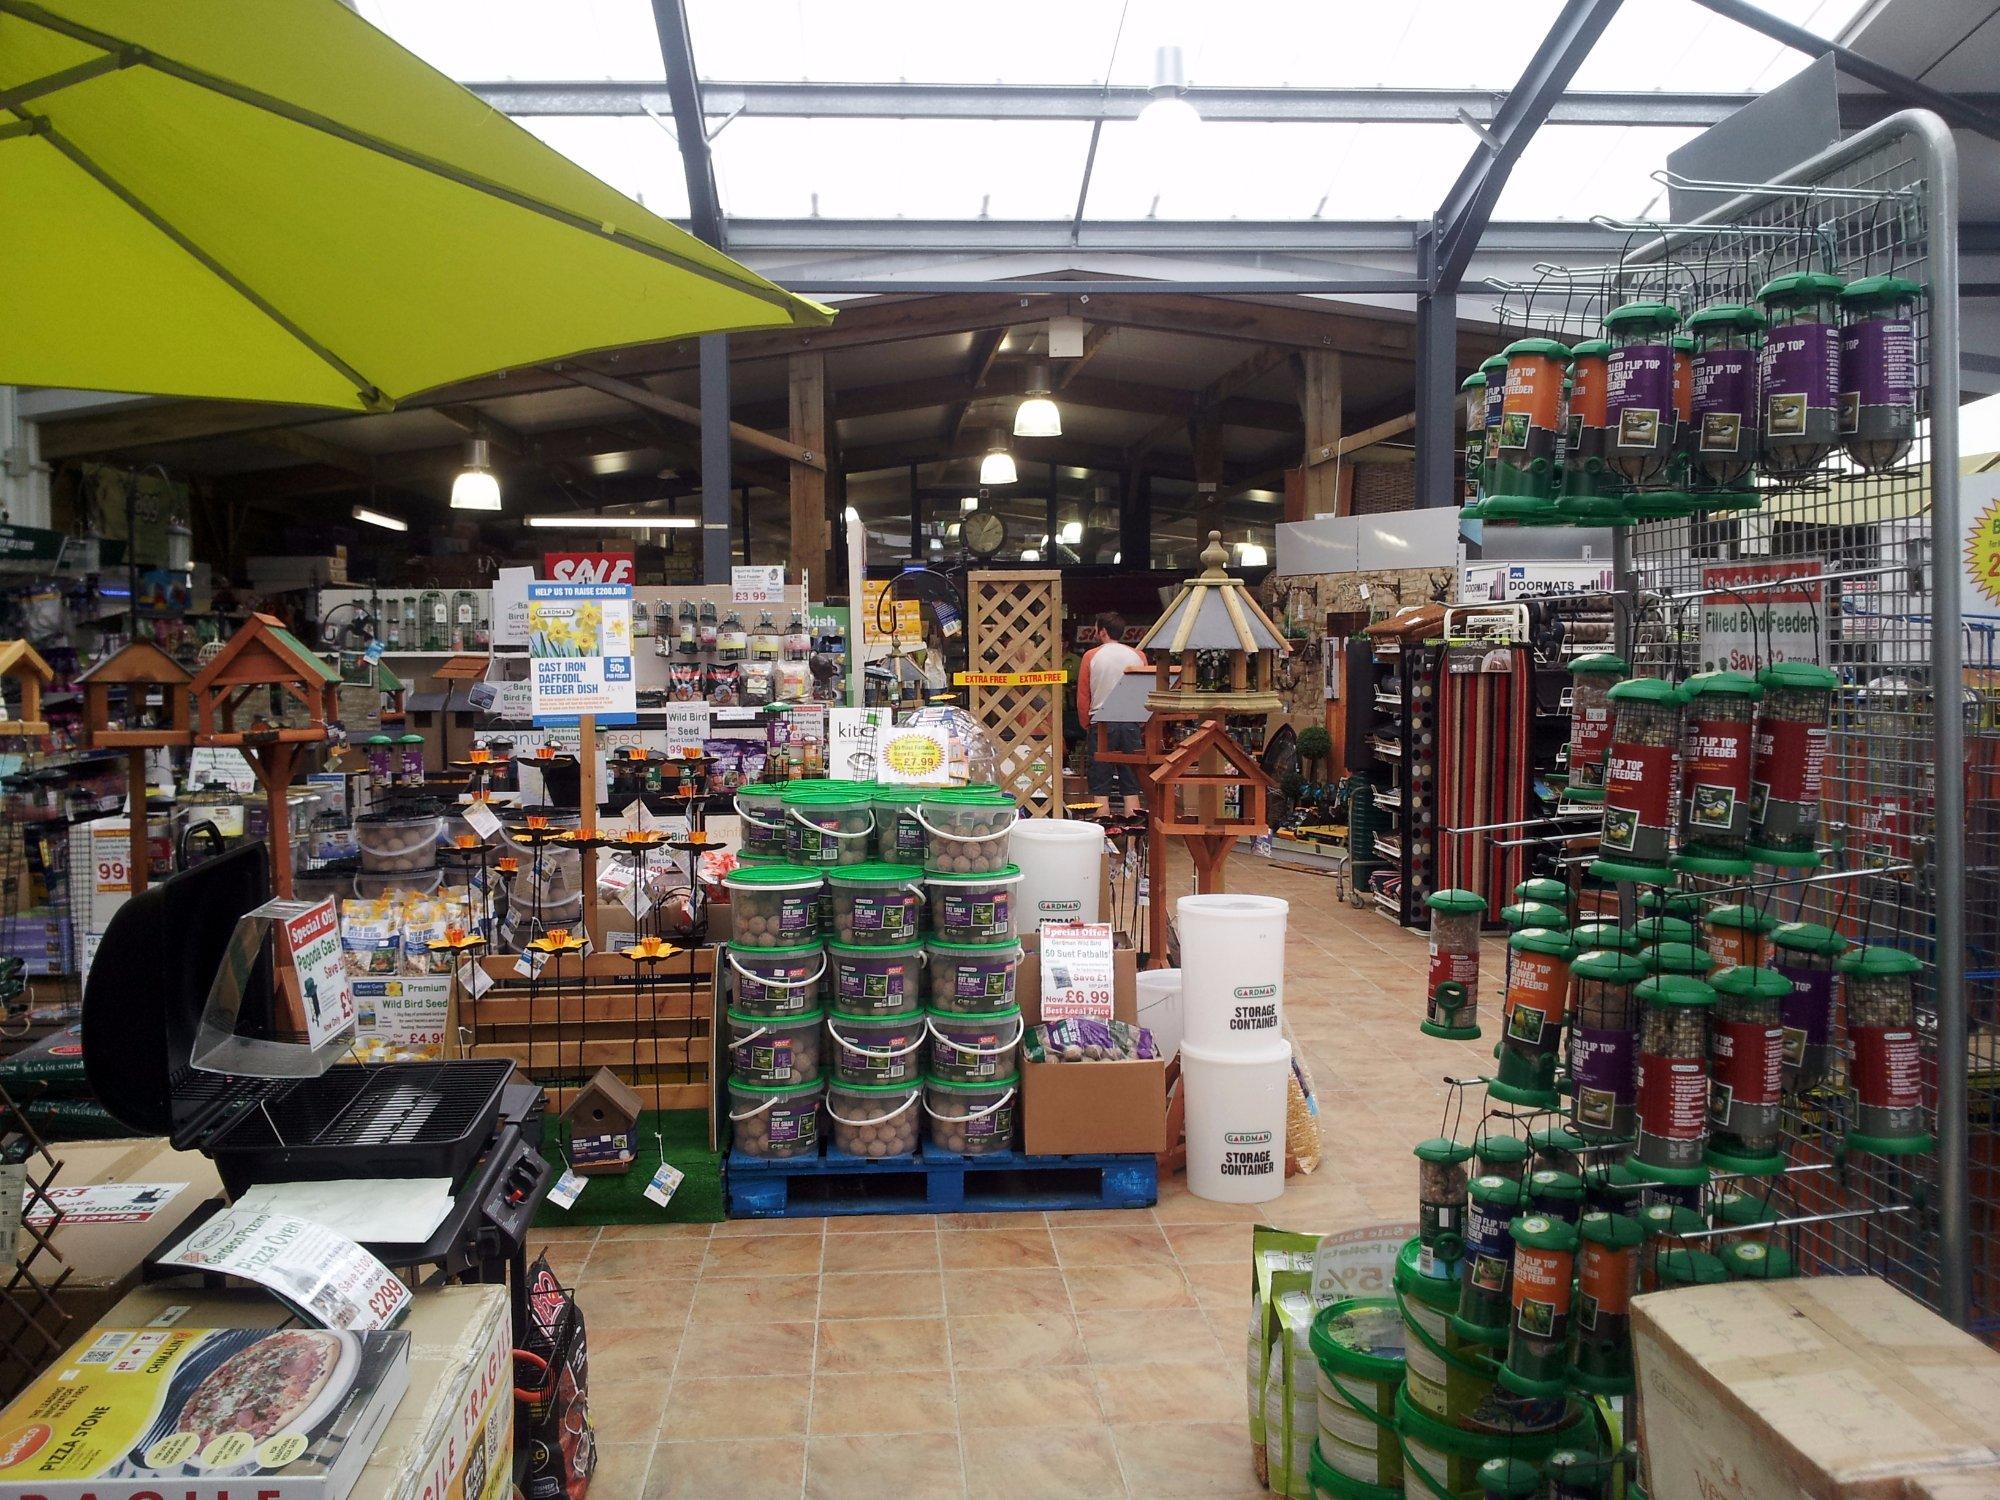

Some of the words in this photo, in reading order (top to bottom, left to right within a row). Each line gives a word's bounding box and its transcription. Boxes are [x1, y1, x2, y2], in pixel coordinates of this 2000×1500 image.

[1769, 342, 1785, 353] FLIP
[1788, 340, 1805, 351] TOP
[1625, 360, 1642, 370] FLIP
[1645, 360, 1660, 369] TOP
[1706, 366, 1723, 375] FLIP
[1726, 364, 1741, 374] TOP
[1522, 368, 1536, 377] TOP
[1511, 386, 1533, 395] FEEDER
[554, 559, 632, 584] SALE
[535, 588, 552, 596] HELP
[553, 588, 564, 596] US
[565, 588, 573, 596] TO
[574, 588, 594, 596] RAISE
[595, 587, 626, 595] £200,000
[1509, 581, 1575, 591] DOORMATS
[735, 592, 766, 601] £3.99
[1705, 613, 1738, 634] Filled
[1741, 612, 1766, 633] Bird
[1770, 613, 1820, 634] Feeders
[1731, 649, 1763, 671] Save
[538, 662, 561, 673] CAST
[565, 662, 586, 672] IRON
[610, 664, 625, 674] 50p
[538, 673, 582, 684] DAFFODIL
[965, 675, 988, 684] EXTRA
[990, 675, 1008, 684] FREE
[1020, 674, 1042, 683] EXTRA
[1044, 673, 1061, 682] FREE
[539, 685, 574, 695] FEEDER
[577, 684, 598, 694] DISH
[668, 713, 687, 721] Wild
[689, 712, 707, 721] Bird
[677, 726, 699, 735] Seed
[1699, 737, 1718, 747] FLIP
[1721, 737, 1737, 747] TOP
[1703, 747, 1737, 758] FEEDER
[903, 758, 934, 766] £7.99
[1611, 759, 1624, 769] FLIP
[1626, 760, 1643, 771] TOP
[1612, 770, 1643, 781] FEEDER
[1038, 901, 1081, 911] GARDMAN
[291, 915, 322, 943] Special
[1044, 928, 1079, 939] Special
[1081, 928, 1107, 937] Offer
[1724, 939, 1738, 948] TOP
[297, 944, 322, 973] Pagoda
[321, 938, 336, 958] Gas
[1045, 950, 1055, 958] 50
[1057, 950, 1075, 958] Suet
[1077, 950, 1108, 959] Fatballs
[324, 963, 339, 979] Save
[1520, 961, 1535, 971] FLIP
[1537, 964, 1551, 974] TOP
[1097, 974, 1107, 982] £1
[408, 984, 447, 992] Premium
[1520, 980, 1549, 991] FEEDER
[1795, 982, 1811, 992] TOP
[1065, 990, 1109, 1003] £6.99
[1235, 986, 1276, 998] GARDMAN
[383, 1000, 401, 1008] Wild
[404, 1000, 424, 1008] Bird
[426, 1000, 448, 1008] Seed
[1046, 1007, 1063, 1015] Best
[1065, 1007, 1086, 1015] Local
[1088, 1007, 1110, 1015] Price
[1235, 1004, 1276, 1018] STORAGE
[1229, 1016, 1278, 1030] CONTAINER
[1582, 1040, 1598, 1052] FLIP
[1600, 1043, 1615, 1053] TOP
[1226, 1132, 1271, 1143] GARDMAN
[1225, 1150, 1270, 1163] STORAGE
[1220, 1162, 1274, 1176] CONTAINER
[84, 1205, 156, 1213] Pagoda
[1483, 1217, 1497, 1228] FLIP
[1481, 1225, 1498, 1236] SEED
[204, 1234, 244, 1265] Gardeco
[236, 1240, 275, 1271] Pizza
[271, 1221, 304, 1247] Oven
[1527, 1257, 1542, 1267] FLIP
[1543, 1259, 1557, 1269] TOP
[338, 1270, 360, 1291] Save
[356, 1254, 374, 1275] £100
[1529, 1274, 1556, 1285] FEEDER
[369, 1277, 403, 1320] £299
[145, 1338, 186, 1374] CHIMALIN
[463, 1317, 512, 1441] FRAGILE
[38, 1440, 80, 1472] PIZZA
[75, 1405, 111, 1438] STONE
